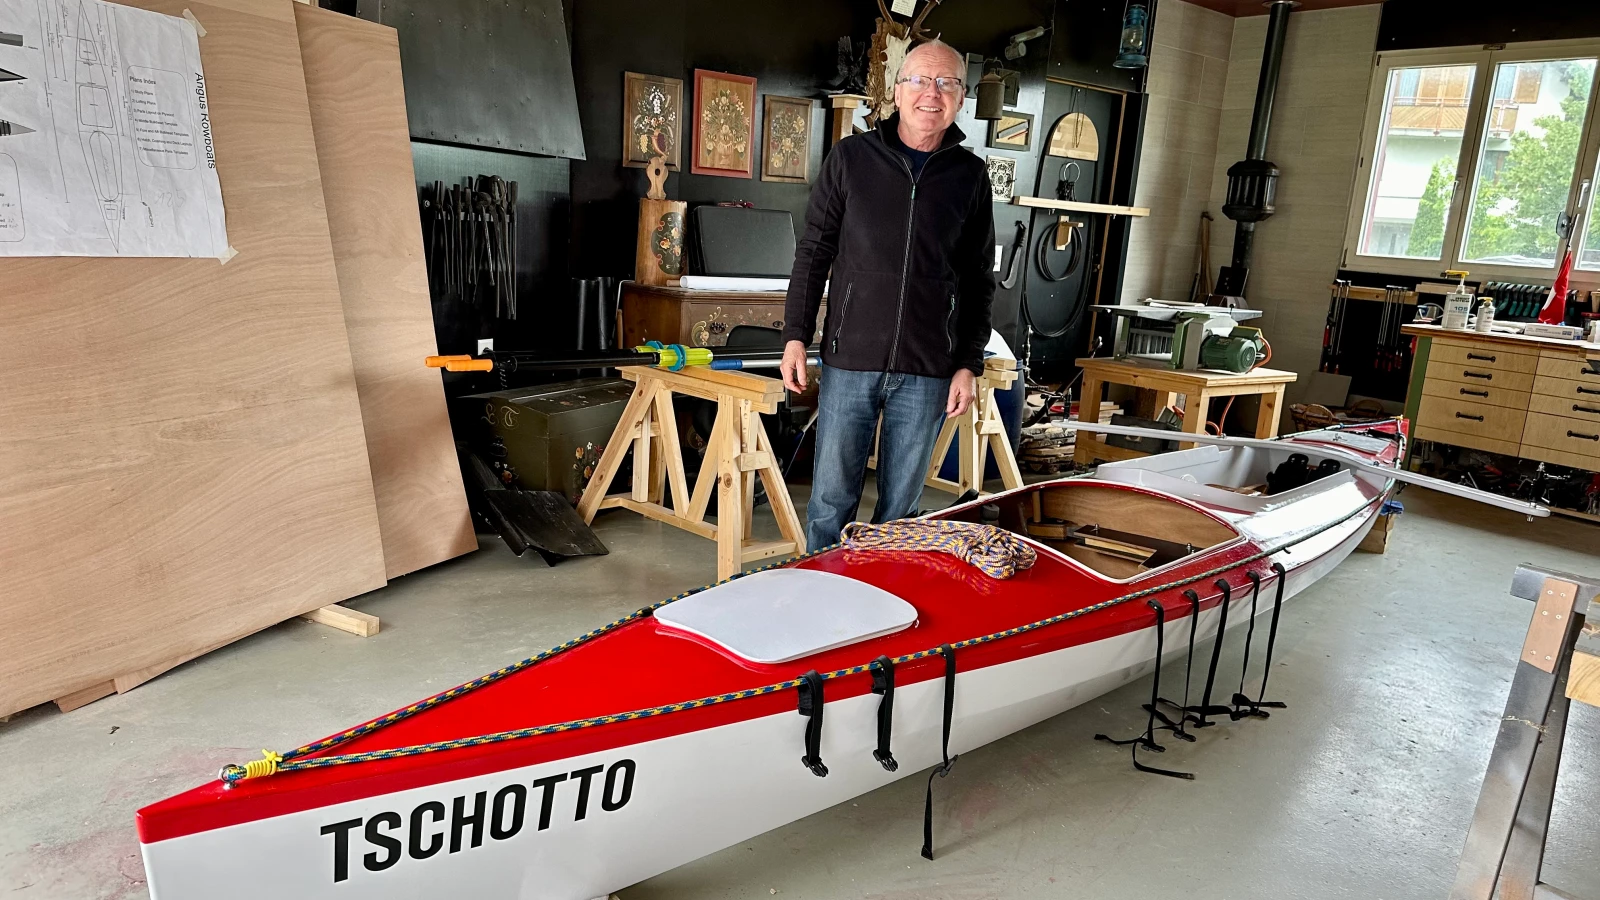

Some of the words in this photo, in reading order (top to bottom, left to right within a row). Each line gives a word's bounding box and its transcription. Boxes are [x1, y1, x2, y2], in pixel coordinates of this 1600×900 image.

[130, 75, 142, 83] Plans
[195, 72, 206, 109] Angus
[320, 758, 637, 883] TSCHOTTO
